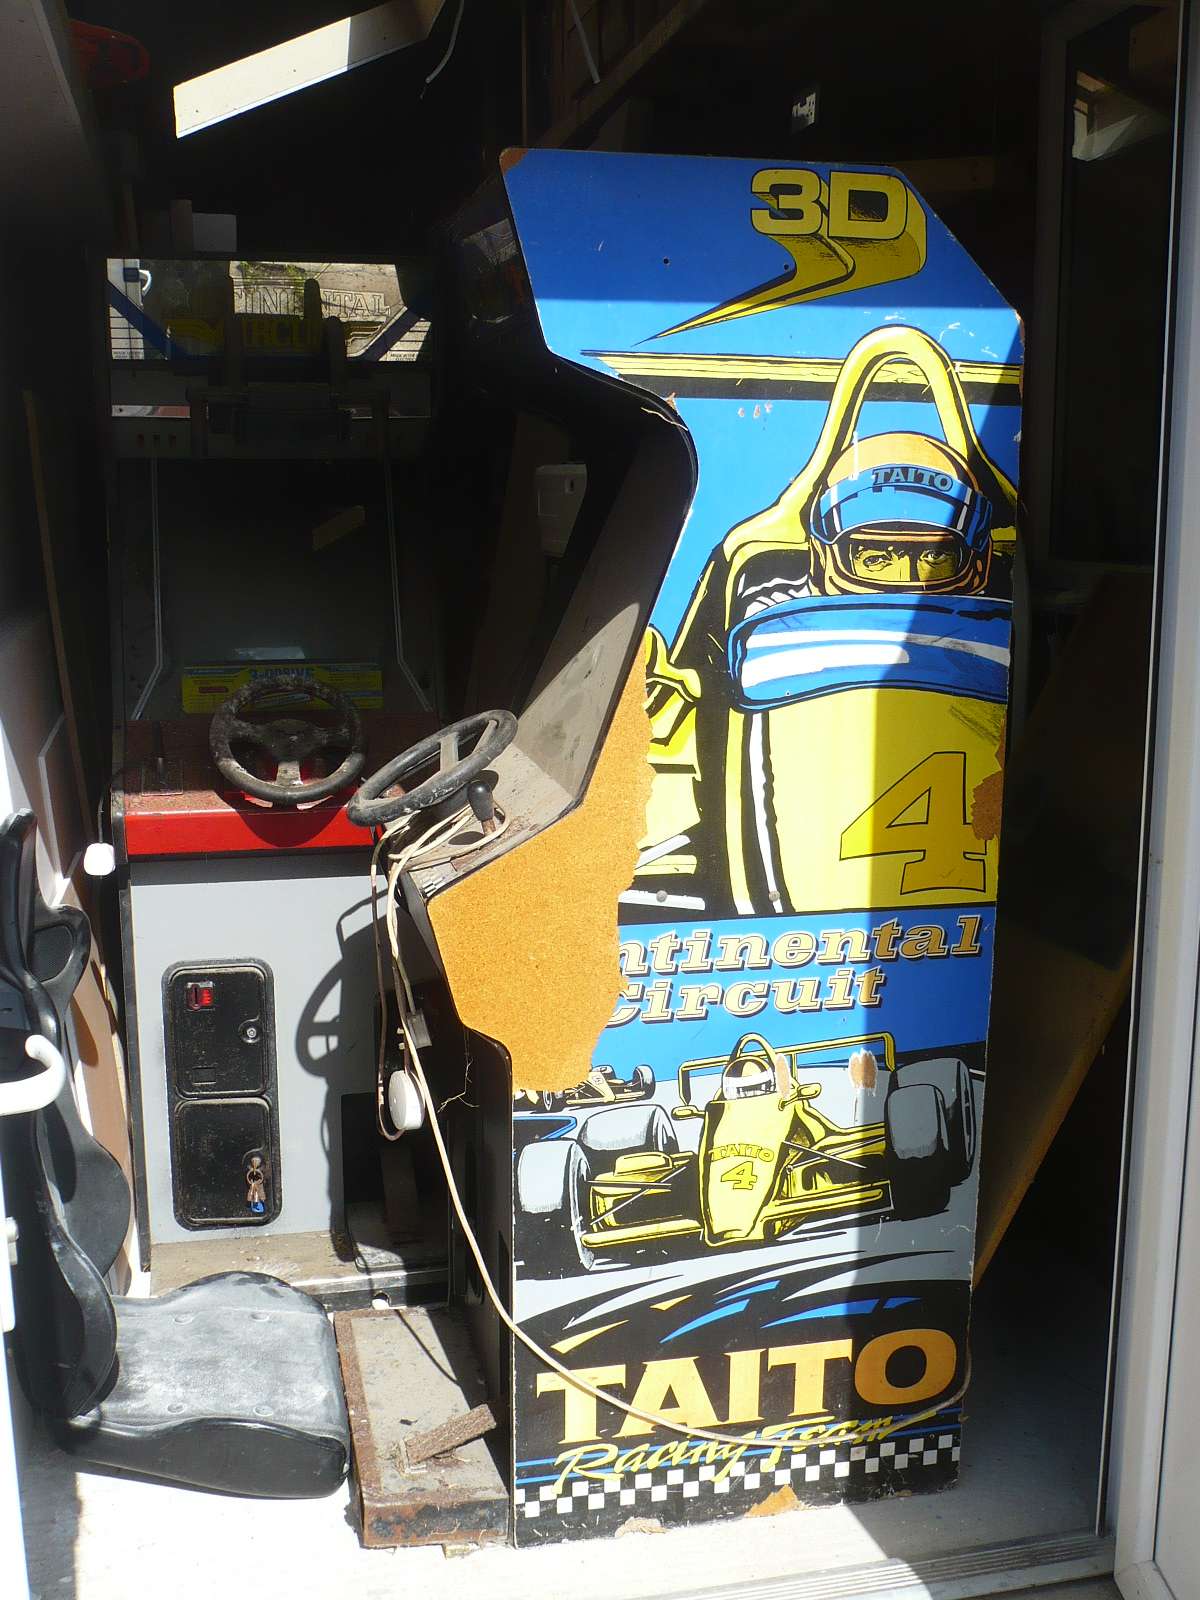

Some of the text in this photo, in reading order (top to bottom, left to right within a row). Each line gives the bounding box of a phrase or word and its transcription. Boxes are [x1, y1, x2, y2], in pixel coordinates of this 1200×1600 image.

[750, 167, 926, 245] 3D
[873, 467, 954, 492] TAITO
[839, 750, 987, 896] 4
[708, 1143, 775, 1163] TAITO
[720, 1160, 758, 1190] 4
[537, 1328, 957, 1445] TAITO
[551, 1408, 939, 1495] Racing Team
